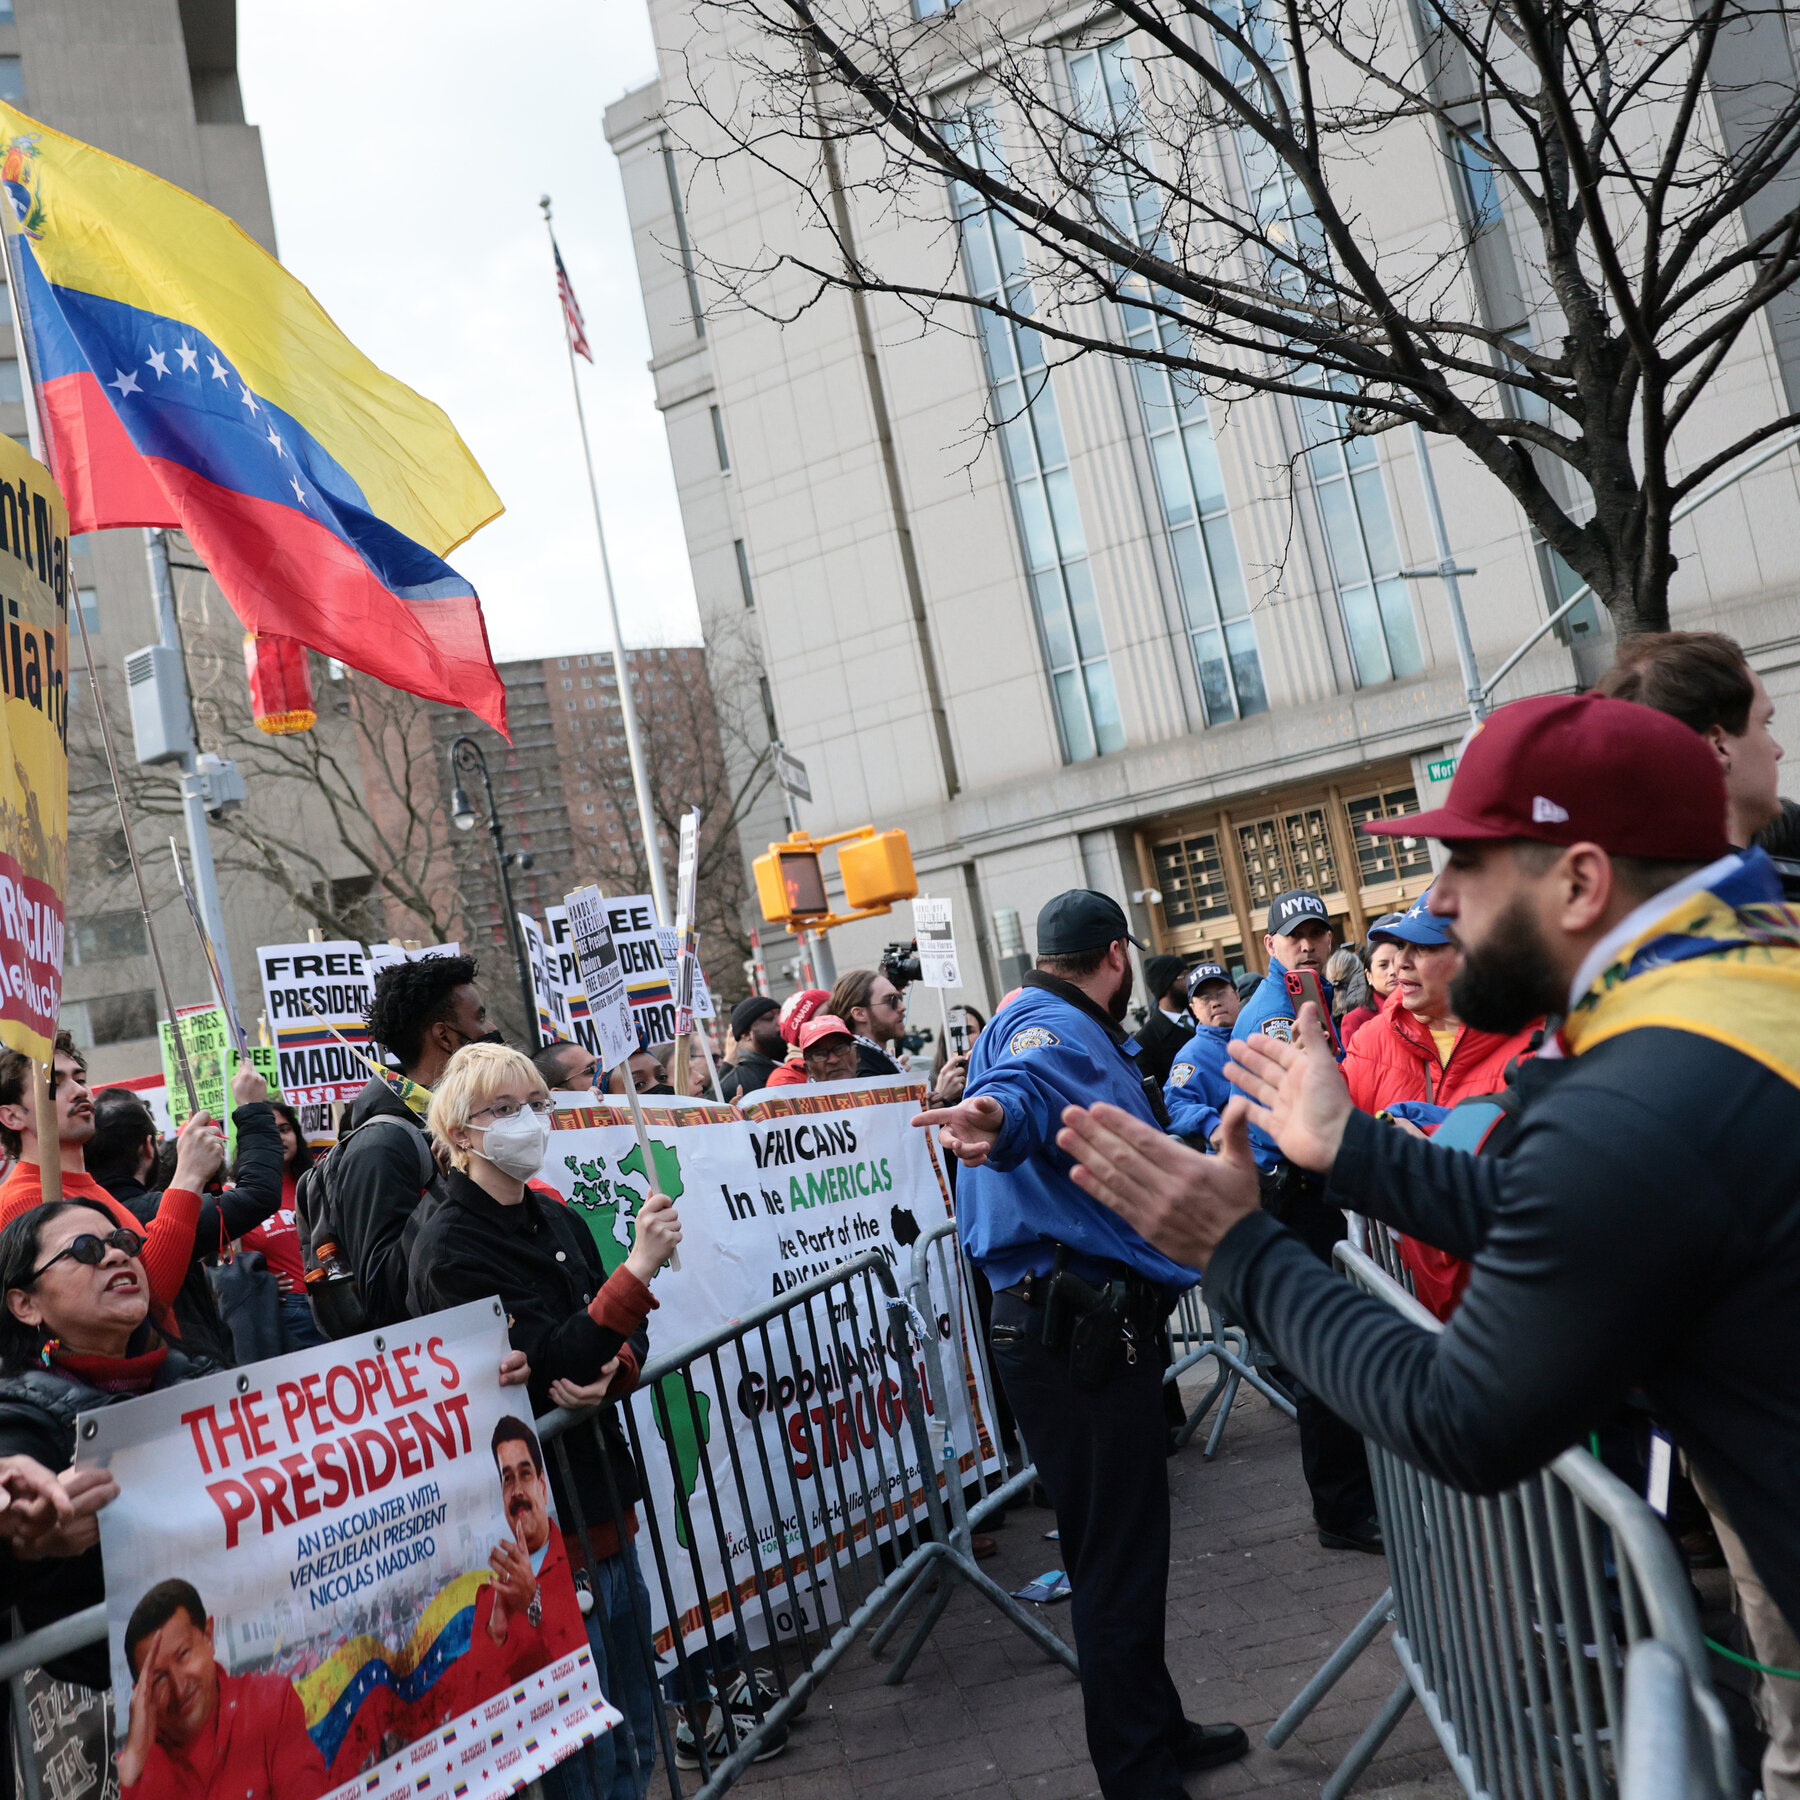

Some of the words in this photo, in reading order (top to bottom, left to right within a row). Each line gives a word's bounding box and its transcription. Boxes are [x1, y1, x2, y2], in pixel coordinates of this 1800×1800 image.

[552, 906, 653, 944] FEE
[1281, 896, 1324, 918] NYPD
[265, 953, 365, 981] FREE
[559, 939, 664, 986] PDENT
[1189, 965, 1221, 985] NYPD
[269, 985, 372, 1019] PRESIDENT
[585, 976, 599, 995] FREE
[791, 1000, 814, 1031] CANADA
[168, 1032, 214, 1060] MDURO
[233, 1049, 271, 1067] FEE
[279, 1045, 378, 1088] MADURO
[720, 1183, 757, 1221] In
[789, 1157, 893, 1212] AMERICAS
[800, 1226, 834, 1256] Part
[837, 1214, 852, 1247] of
[853, 1212, 880, 1243] the
[181, 1390, 278, 1475] THE
[276, 1336, 461, 1444] PEOPLE'S
[205, 1393, 472, 1550] PRESIDENT
[297, 1530, 320, 1561] AN
[323, 1495, 406, 1549] ENCOUNTER
[406, 1481, 441, 1513] WITH
[289, 1533, 381, 1592] VENEZUELAN
[383, 1503, 448, 1549] PRESIDENT
[308, 1566, 382, 1611] NICOLAS
[376, 1537, 436, 1582] MADURO
